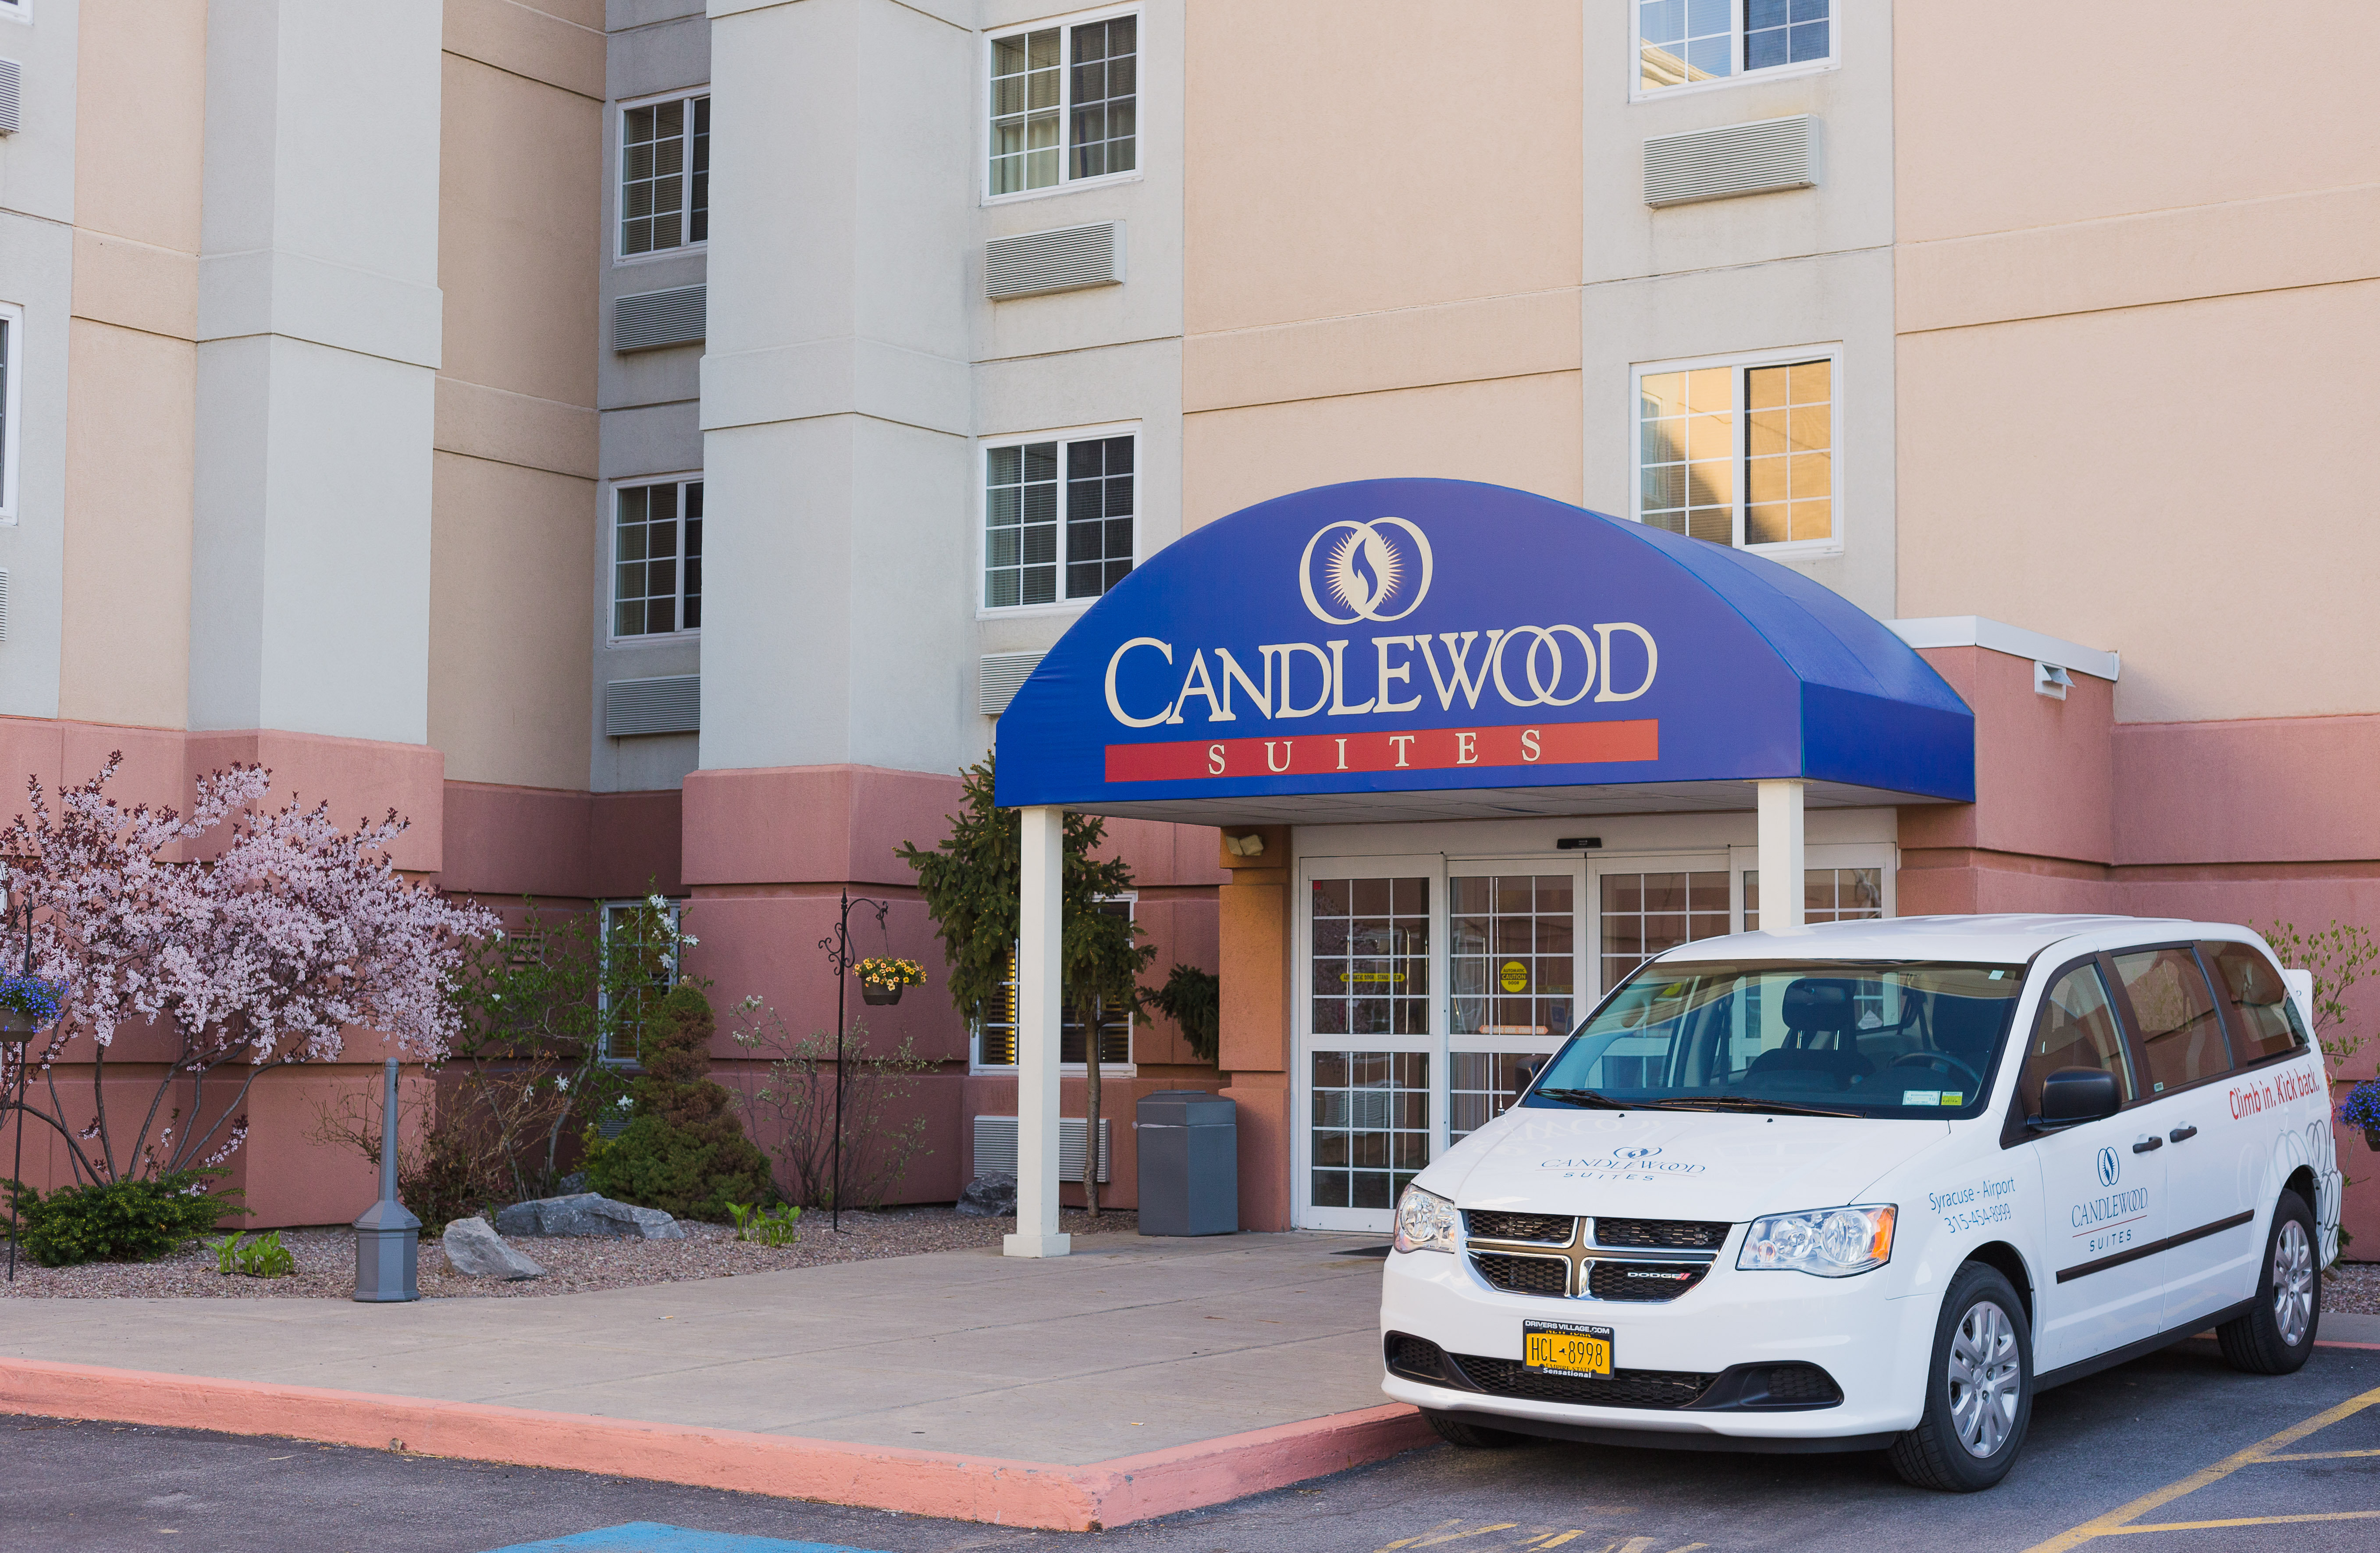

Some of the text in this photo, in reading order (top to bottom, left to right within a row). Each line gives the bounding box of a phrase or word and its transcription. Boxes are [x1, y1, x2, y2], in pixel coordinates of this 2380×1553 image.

[1105, 622, 1658, 728] CANDLEWOOD
[1208, 729, 1541, 775] SUITES
[2230, 1064, 2320, 1120] Climb in. Kick back.
[1541, 1159, 1706, 1174] CANDLEWOOD
[1563, 1172, 1654, 1181] SUITES
[1929, 1188, 1974, 1214] Syracuse
[1983, 1176, 2015, 1200] Airport
[2072, 1187, 2148, 1228] CANDLEWOOD
[1944, 1203, 2011, 1233] 315-454-8999
[2090, 1229, 2131, 1252] SUITES
[1525, 1320, 1558, 1329] DRIVERS
[1558, 1324, 1610, 1334] VILLAGE.COM
[1532, 1337, 1603, 1367] HCL 8998
[1543, 1367, 1591, 1378] Sensational
